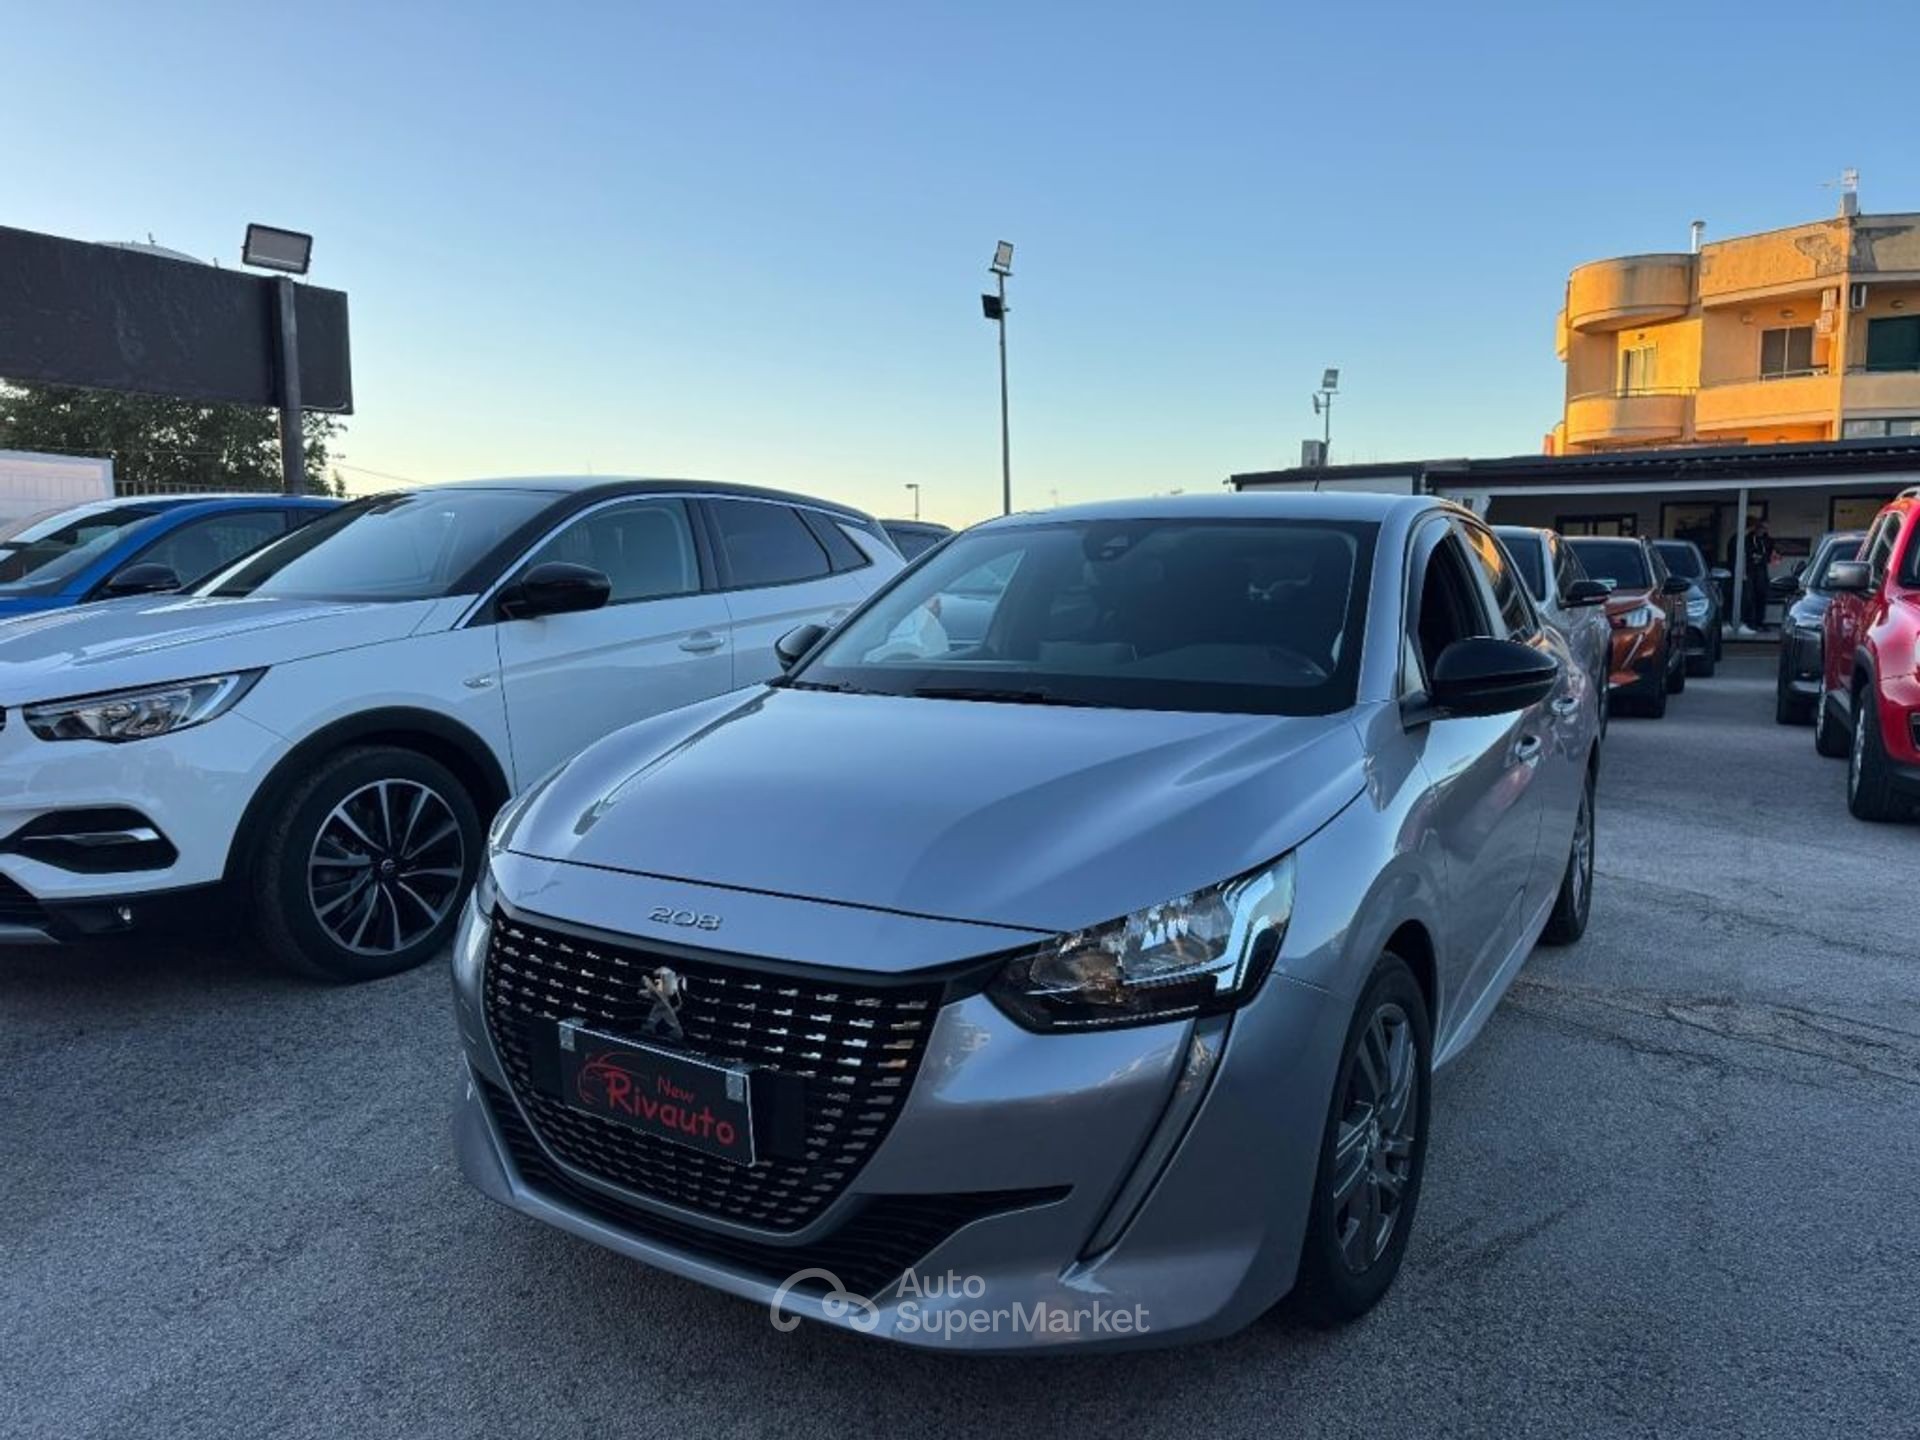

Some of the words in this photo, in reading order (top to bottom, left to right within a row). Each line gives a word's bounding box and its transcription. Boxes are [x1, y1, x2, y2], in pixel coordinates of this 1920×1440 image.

[647, 906, 723, 931] 208
[657, 1074, 695, 1104] New
[603, 1068, 735, 1145] Rivauto
